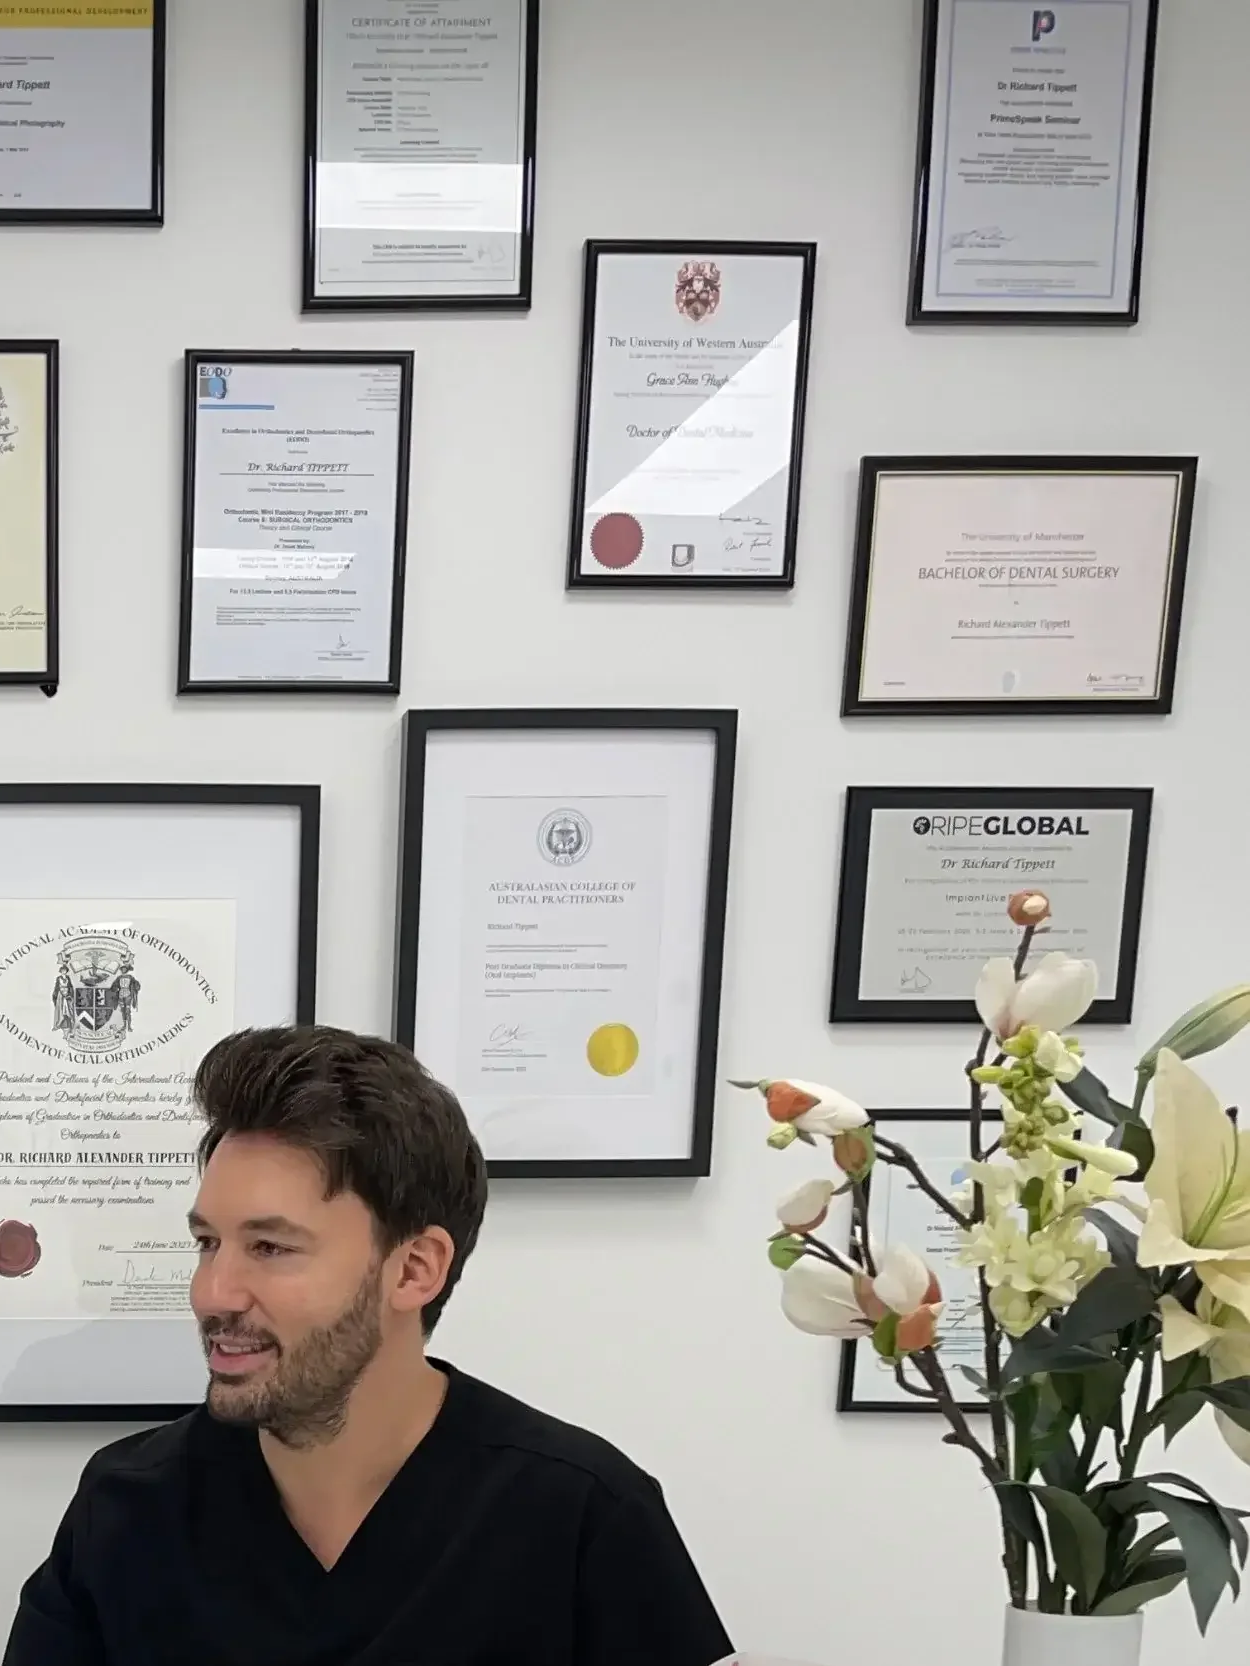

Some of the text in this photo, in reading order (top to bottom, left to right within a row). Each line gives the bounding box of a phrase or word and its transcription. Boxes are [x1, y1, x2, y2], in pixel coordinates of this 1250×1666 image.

[608, 337, 735, 350] The University of Western
[200, 366, 232, 376] EODO
[918, 566, 1119, 580] BACHELOR OF DENTAL SURGERY
[941, 857, 1056, 872] Dr Richard Tippett
[497, 895, 539, 904] DENTAL
[122, 927, 141, 939] OF
[140, 934, 218, 1005] ORTHODONTICS
[18, 1030, 103, 1065] DENTOFACIAL
[104, 1012, 195, 1064] ORTHOPAEDICS
[20, 1152, 72, 1163] RICHARD
[76, 1152, 144, 1164] ALEXANDER
